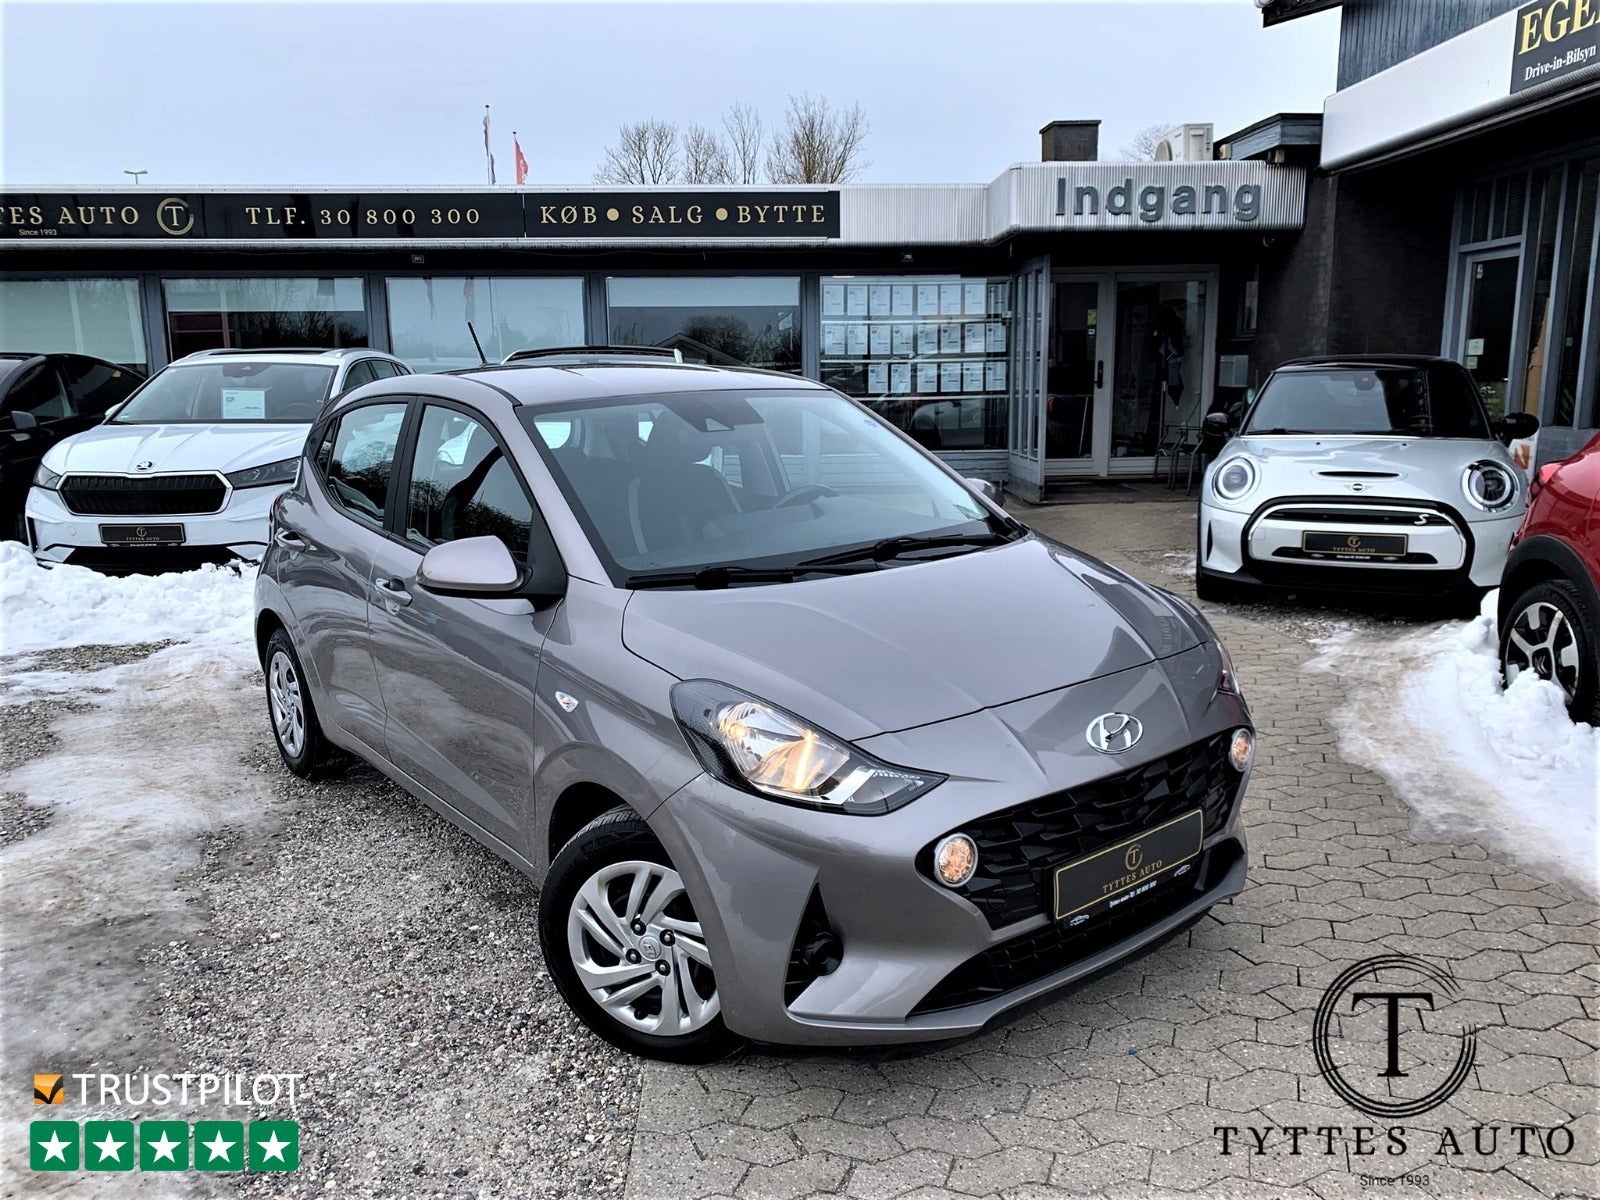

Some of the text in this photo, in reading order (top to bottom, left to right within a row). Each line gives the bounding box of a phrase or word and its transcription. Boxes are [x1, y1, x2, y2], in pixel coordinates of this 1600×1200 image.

[1518, 0, 1600, 55] EGE
[1523, 45, 1597, 81] Drive-in-Bilsyn
[1055, 177, 1262, 222] Indgang
[57, 206, 139, 225] AUTO
[245, 207, 480, 225] TLF. 30 800 300
[540, 205, 826, 225] KØB SALG BYTTE
[18, 228, 57, 236] Since 1993
[1102, 860, 1163, 893] TYTTES AUTO
